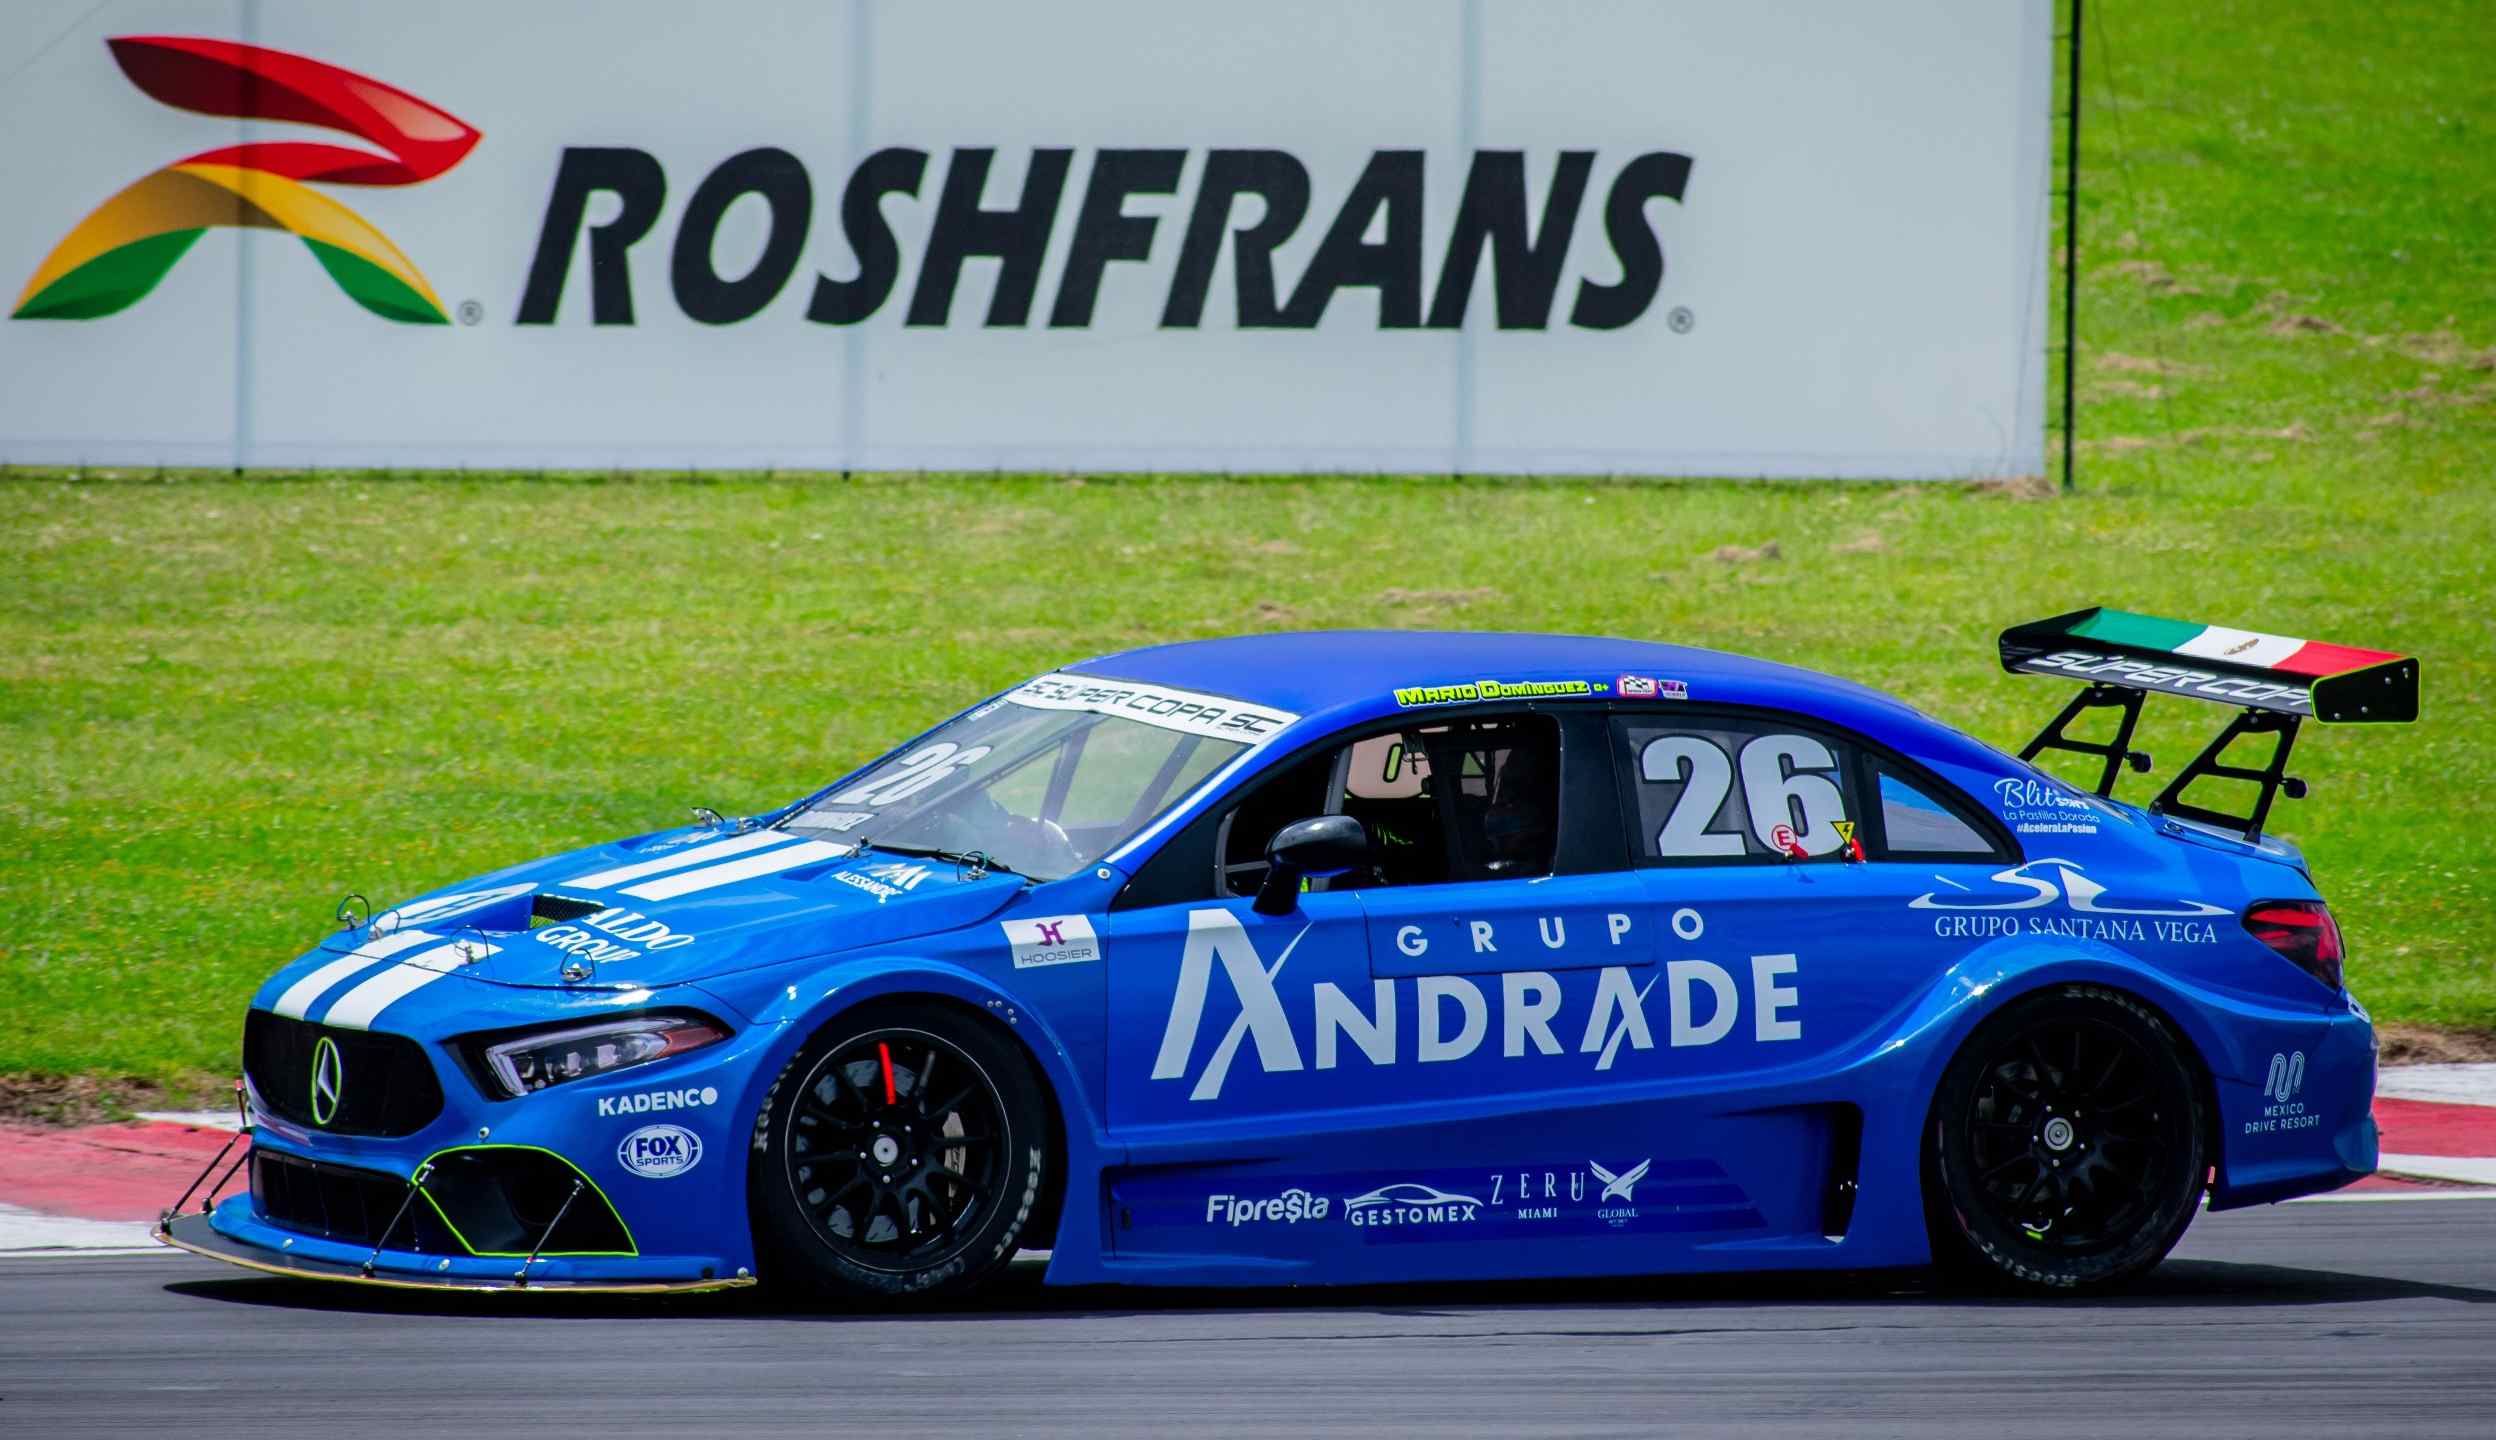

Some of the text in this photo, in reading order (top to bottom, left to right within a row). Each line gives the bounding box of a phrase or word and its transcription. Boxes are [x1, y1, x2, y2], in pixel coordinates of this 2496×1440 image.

[513, 147, 1694, 333] ROSHFRANS
[1396, 686, 1478, 706] MARIO
[831, 742, 993, 806] 26
[1640, 733, 1847, 857] 26
[582, 907, 696, 950] ALDO
[1397, 907, 1705, 957] GRUPO
[1934, 916, 2217, 944] GRUPO SANTANA VEGA
[1021, 948, 1092, 965] HOOSIER
[1151, 908, 1801, 1101] ANDRADE
[598, 1087, 718, 1117] KADENCO
[2263, 1102, 2305, 1117] MEXICO
[2244, 1114, 2321, 1134] DRIVE RESORT
[635, 1136, 682, 1158] FOX
[636, 1156, 684, 1167] SPORTS
[1350, 1205, 1477, 1226] GESTOMEX
[1518, 1207, 1558, 1219] MIAMI
[1597, 1207, 1639, 1219] GLOBAL
